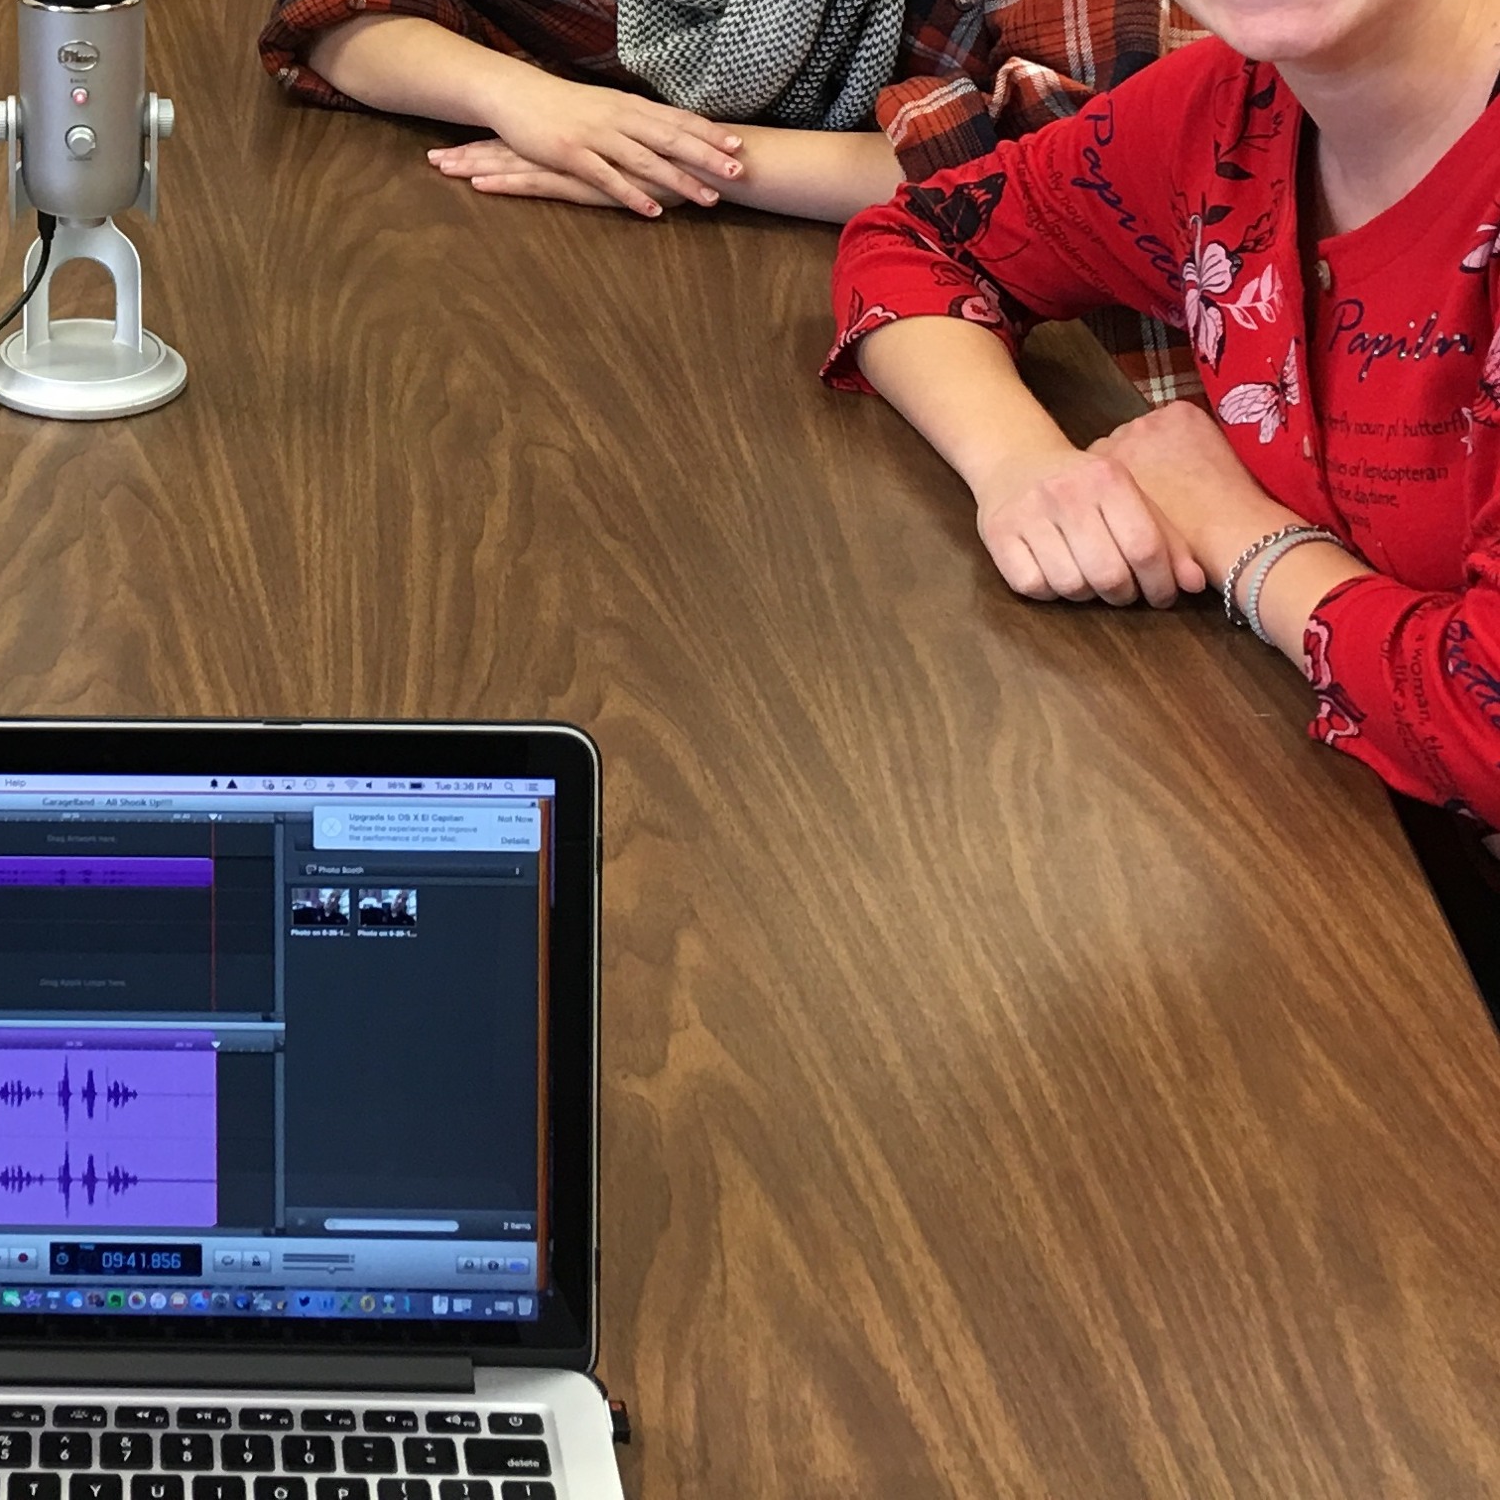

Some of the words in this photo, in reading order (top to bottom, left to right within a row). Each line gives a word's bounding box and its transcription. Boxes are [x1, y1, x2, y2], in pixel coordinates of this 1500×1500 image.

[5, 778, 26, 788] Help
[435, 782, 452, 791] Tue
[477, 782, 493, 791] PM
[42, 798, 95, 808] GarageBand
[105, 798, 118, 807] All
[349, 814, 385, 823] Upgrade
[318, 866, 339, 874] Photo
[0, 1449, 10, 1461] 5
[60, 1450, 69, 1461] 6
[122, 1450, 132, 1462] 7
[182, 1451, 192, 1463] 8
[243, 1451, 253, 1463] 9
[304, 1452, 315, 1464] 0
[507, 1458, 540, 1468] delete
[29, 1484, 39, 1496] T
[90, 1484, 101, 1498] Y
[151, 1485, 165, 1498] U
[274, 1487, 288, 1500] O
[338, 1487, 349, 1500] P
